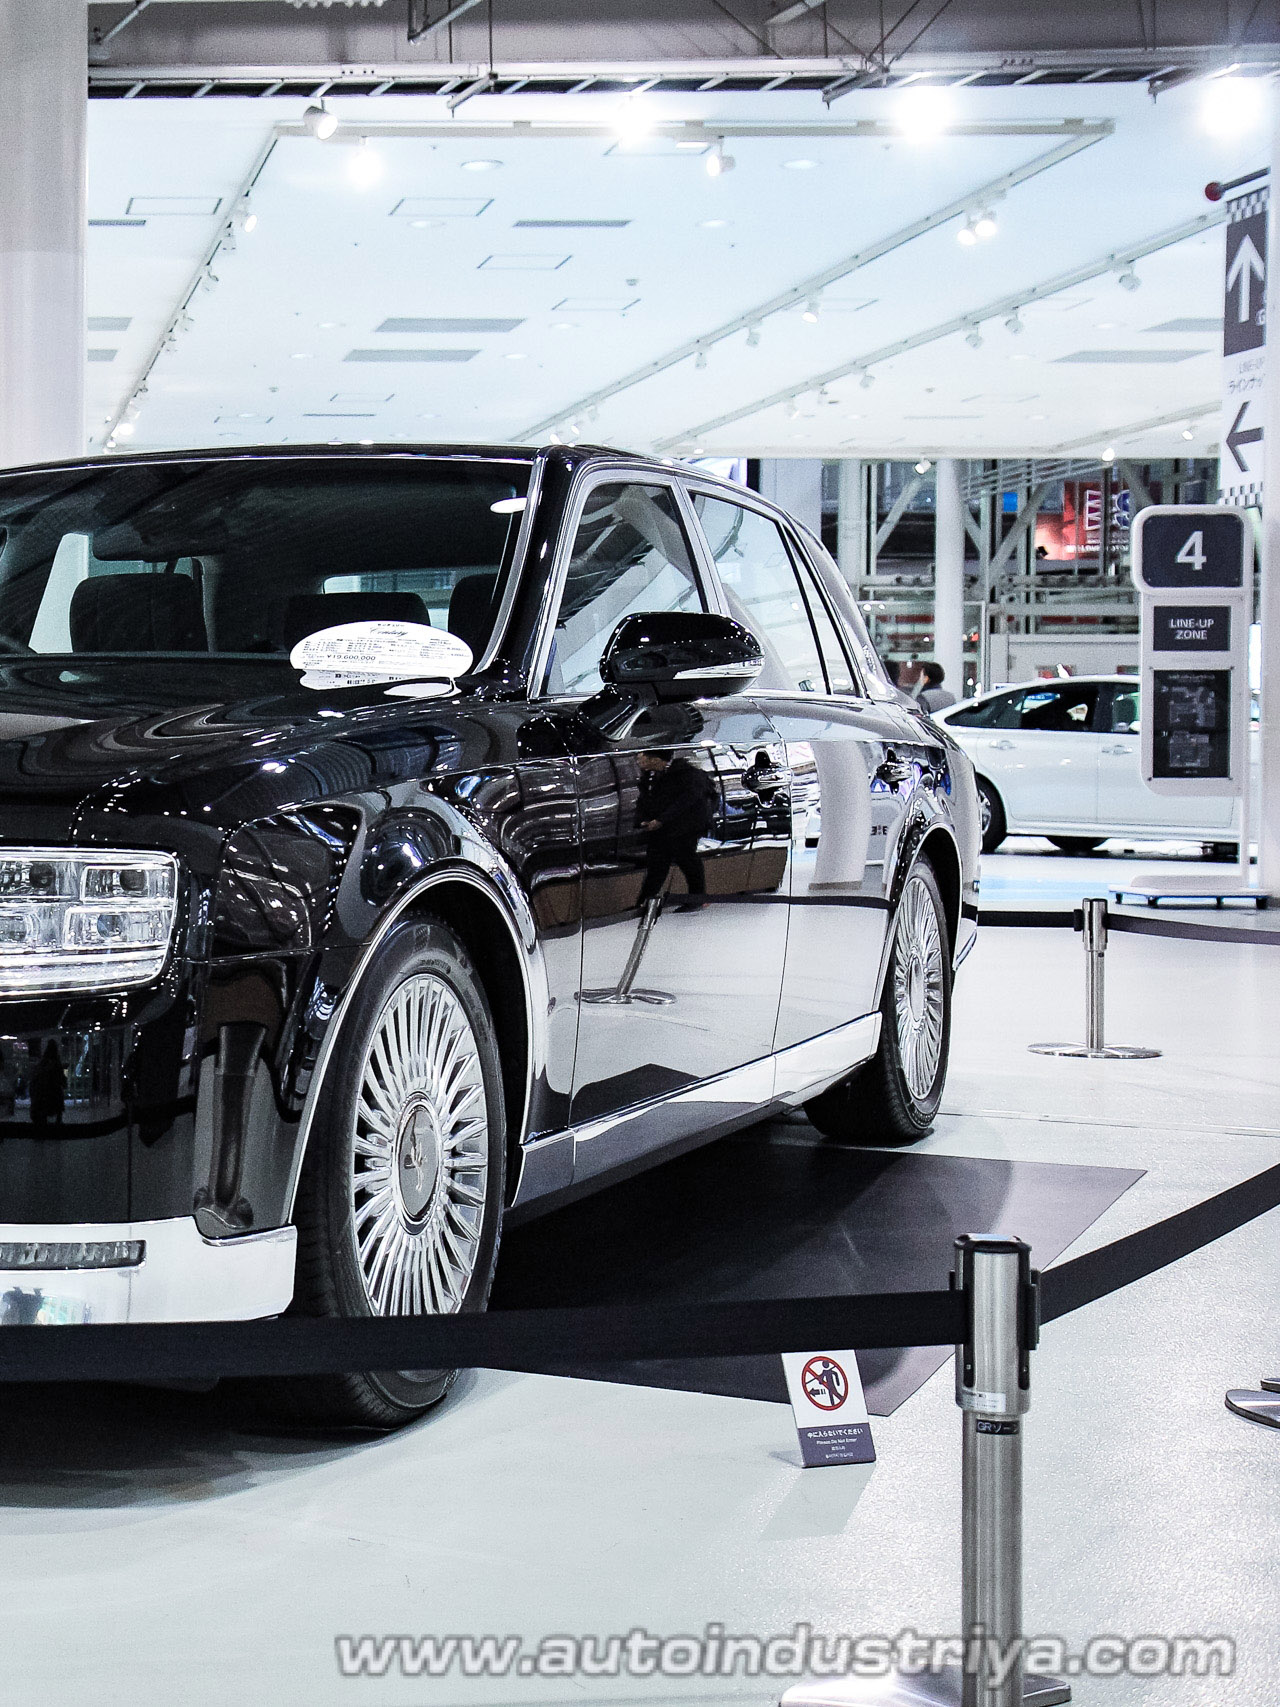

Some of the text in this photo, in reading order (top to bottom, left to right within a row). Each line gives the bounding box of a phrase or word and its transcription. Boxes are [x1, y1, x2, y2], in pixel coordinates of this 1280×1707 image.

[1176, 530, 1207, 571] 4
[1170, 618, 1215, 628] LINE-UP
[1175, 630, 1208, 640] ZONE
